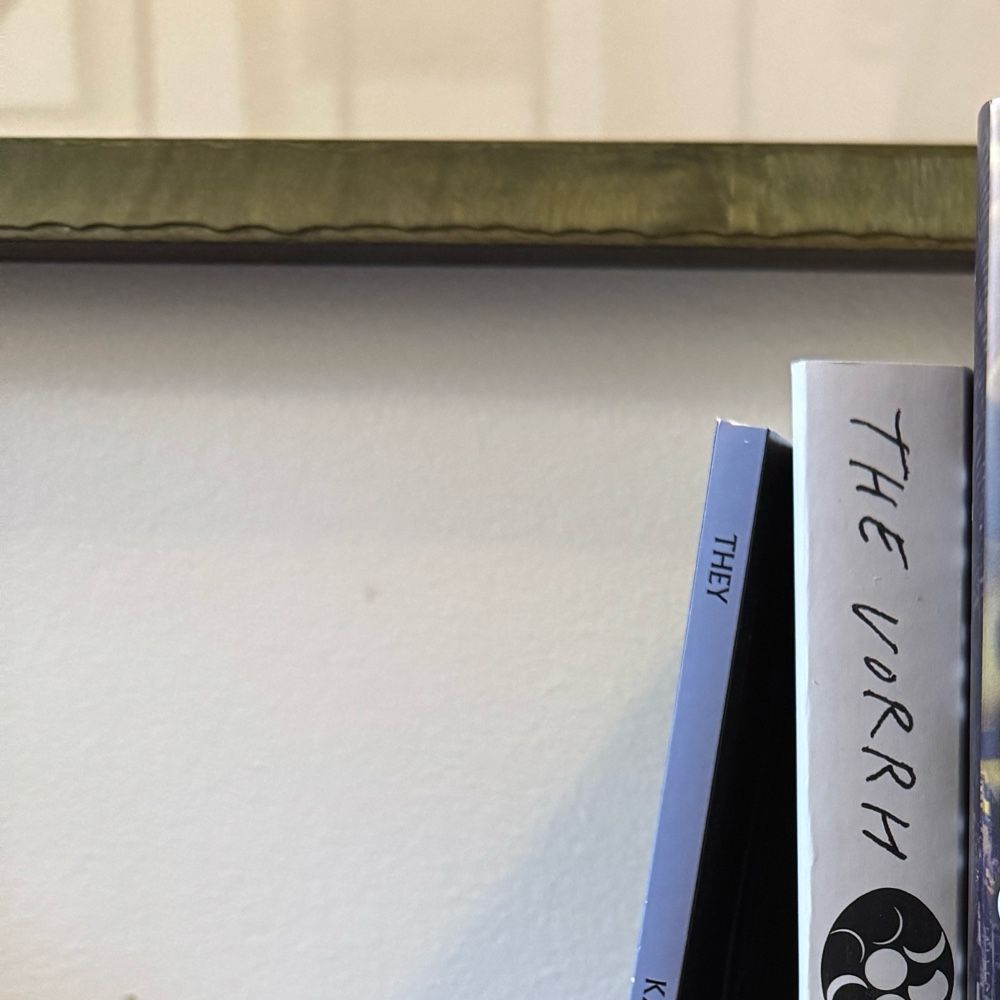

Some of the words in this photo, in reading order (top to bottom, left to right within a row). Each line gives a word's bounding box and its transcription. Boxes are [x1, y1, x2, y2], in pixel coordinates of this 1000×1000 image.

[706, 533, 738, 604] THEY
[849, 408, 910, 571] THE
[851, 602, 917, 861] VORRH
